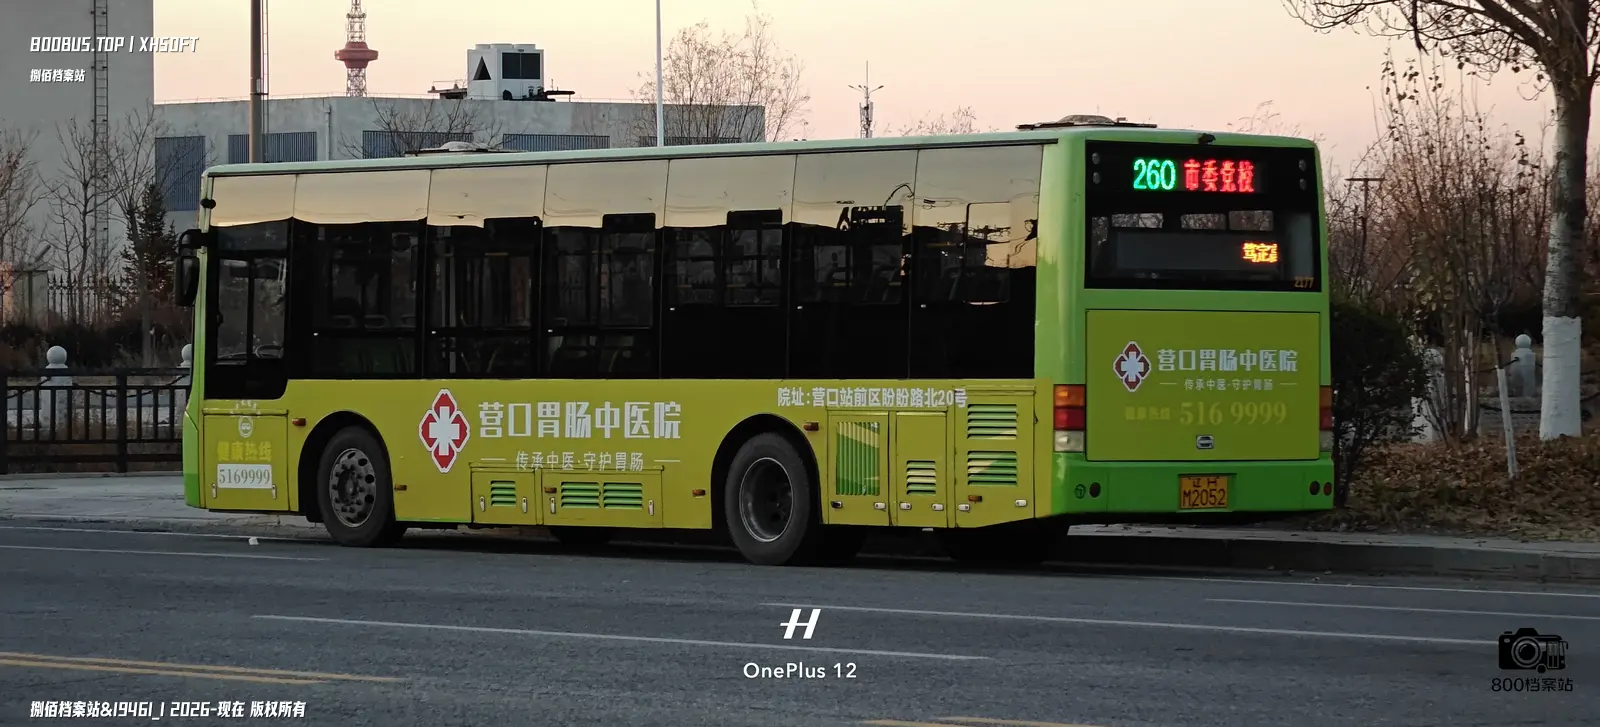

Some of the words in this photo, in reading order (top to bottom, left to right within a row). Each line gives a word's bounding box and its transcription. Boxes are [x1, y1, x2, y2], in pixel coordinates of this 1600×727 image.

[1133, 158, 1176, 190] 260
[1183, 158, 1254, 193] 市委党校
[1157, 349, 1298, 372] 营口胃肠中医院
[478, 401, 681, 439] 营口胃肠中医院
[1180, 402, 1223, 425] 516
[1230, 402, 1287, 424] 9999
[219, 468, 270, 484] 5169999
[1182, 489, 1226, 507] M2052
